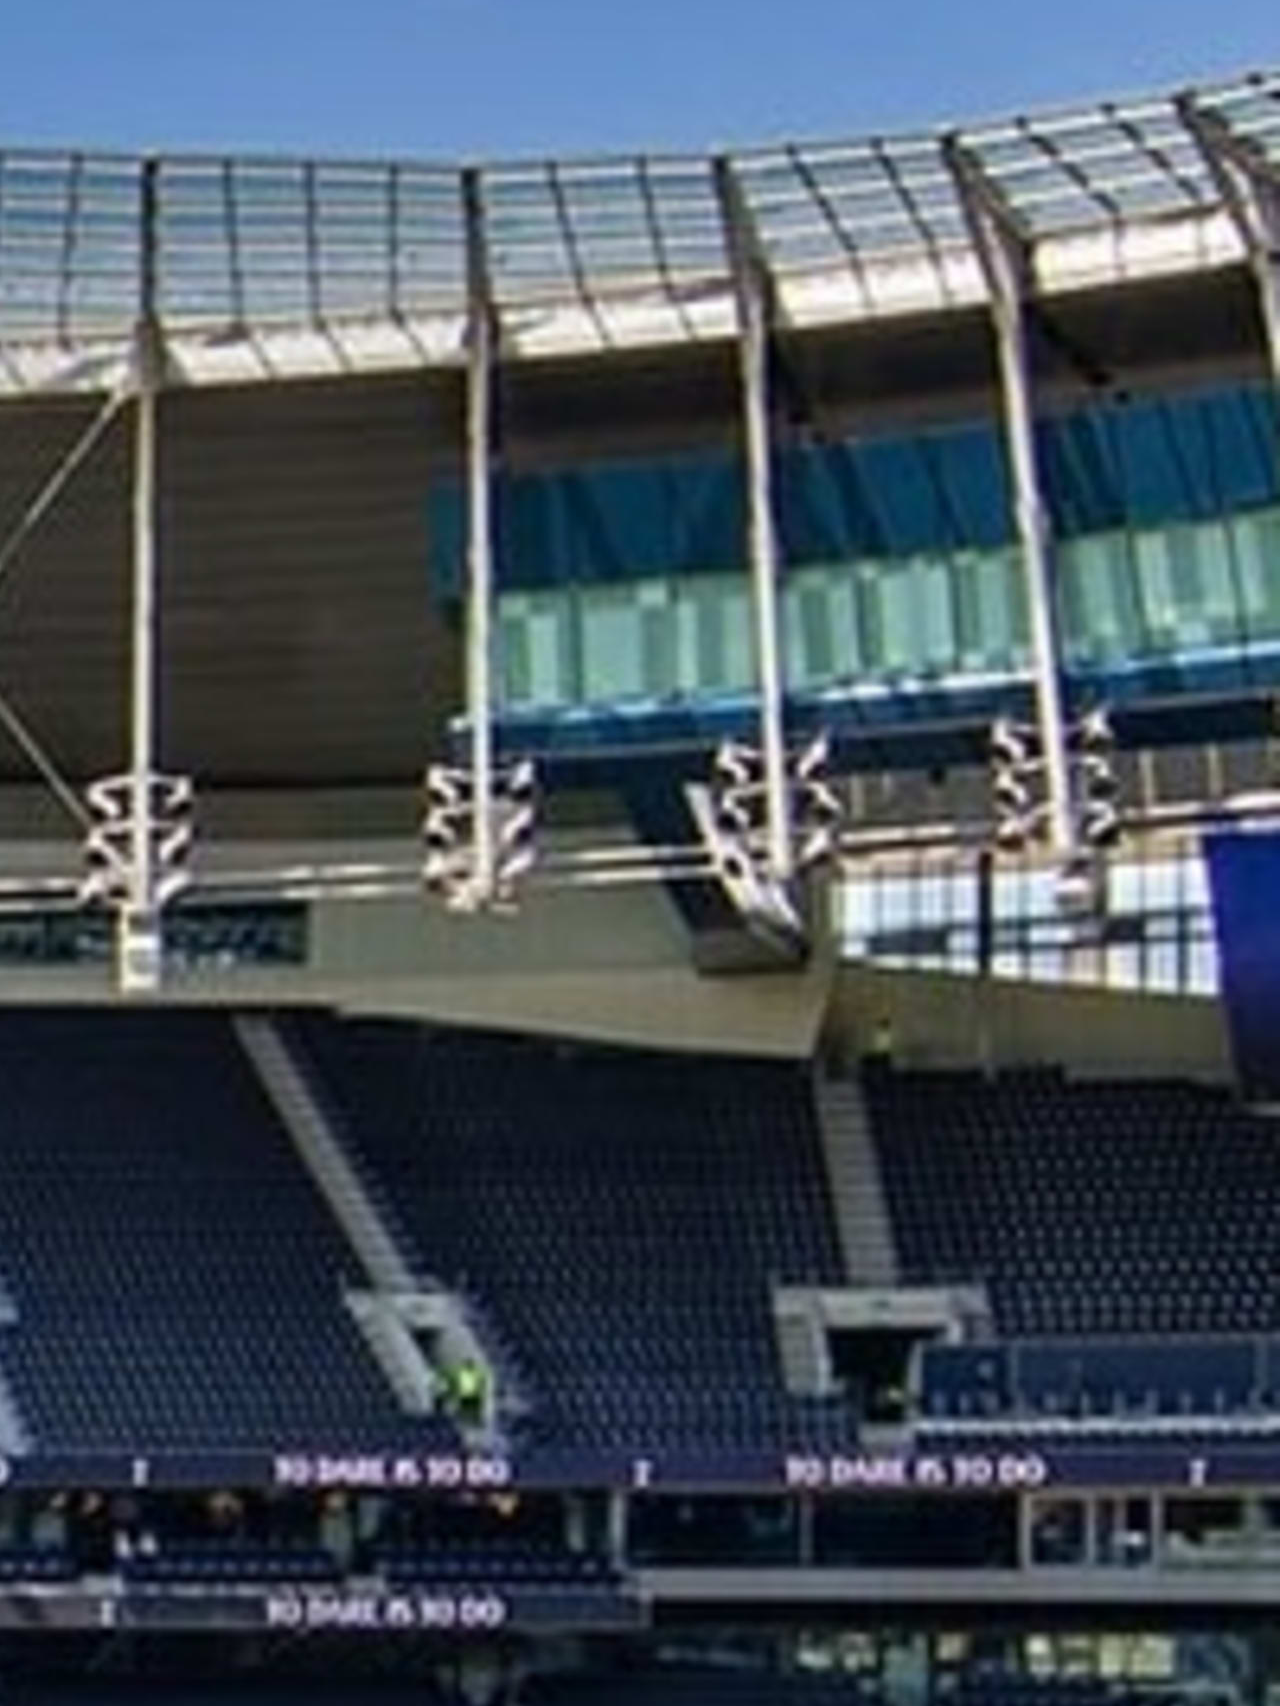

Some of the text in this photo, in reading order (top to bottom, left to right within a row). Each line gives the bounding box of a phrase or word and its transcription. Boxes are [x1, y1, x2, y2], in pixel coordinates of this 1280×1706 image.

[274, 1456, 311, 1486] TO
[427, 1456, 463, 1486] TO
[466, 1456, 510, 1486] DO
[786, 1456, 824, 1486] TO
[953, 1456, 993, 1486] TO
[996, 1456, 1046, 1486] DO
[267, 1597, 302, 1627] TO
[420, 1597, 455, 1627] TO
[458, 1597, 506, 1627] DO
